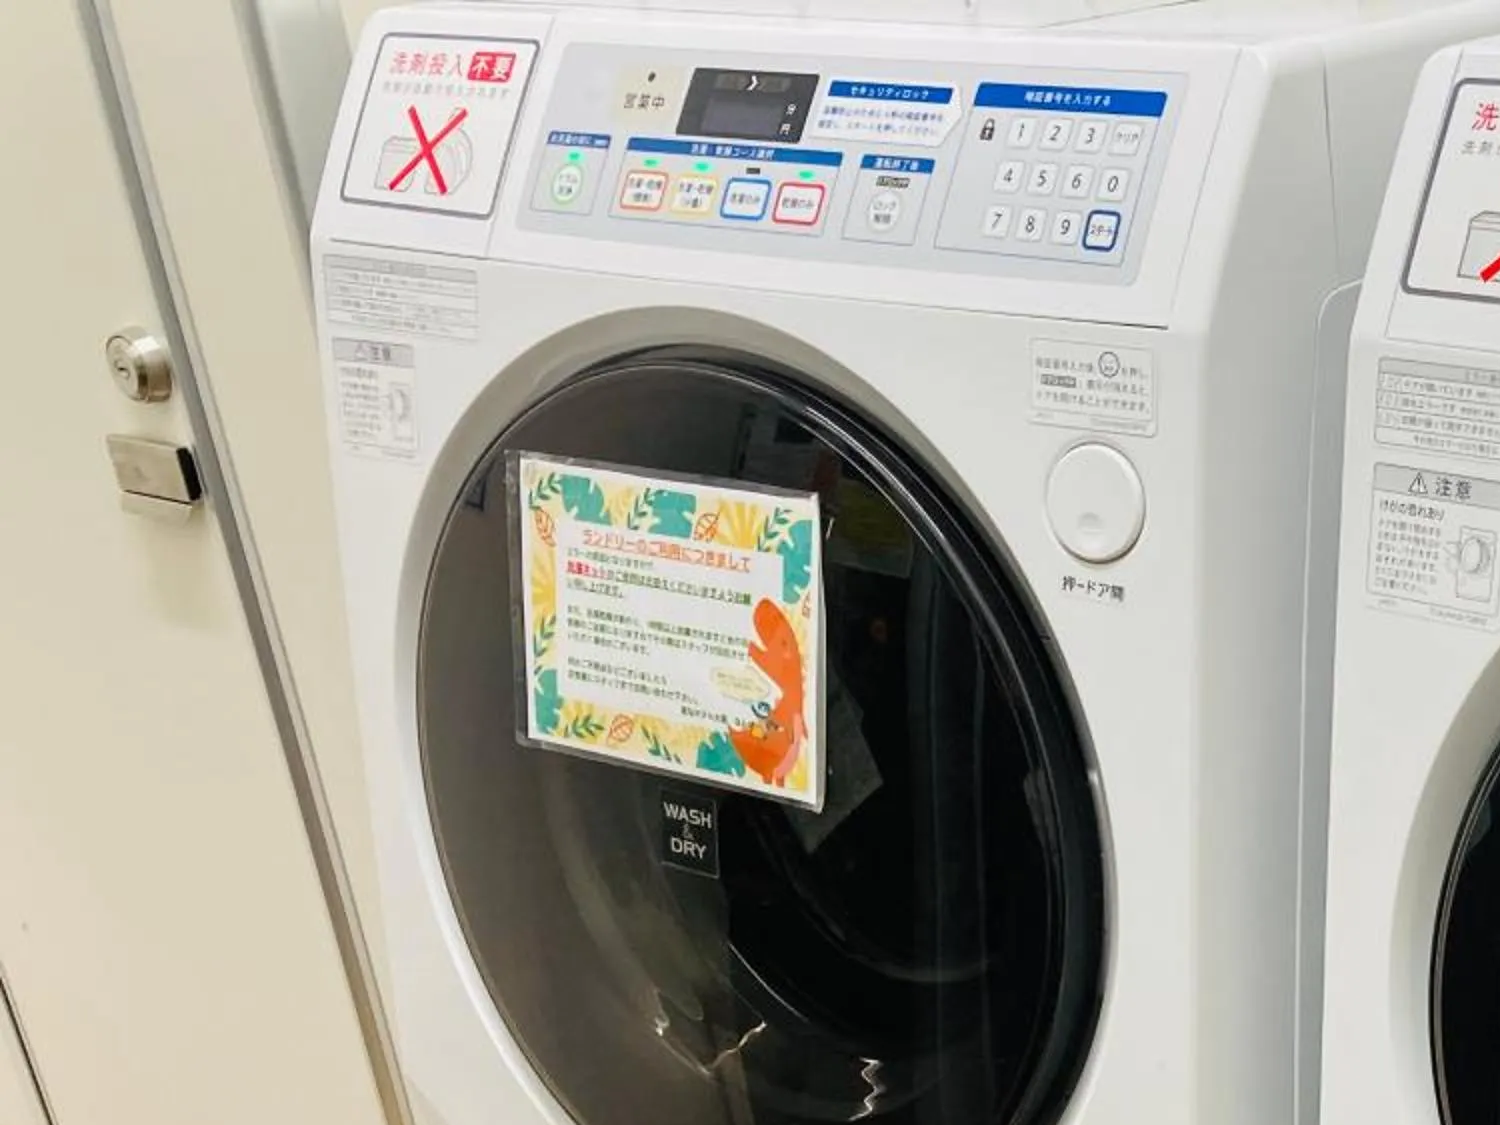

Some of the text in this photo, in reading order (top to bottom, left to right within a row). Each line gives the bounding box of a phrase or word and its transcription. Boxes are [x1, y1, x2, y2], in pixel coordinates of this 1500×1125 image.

[471, 53, 513, 80] 不要
[1050, 125, 1061, 141] 2
[1084, 127, 1096, 144] 3
[1003, 168, 1119, 193] 4 5 6 0
[992, 213, 1071, 235] 7 8 9
[1435, 477, 1473, 499] 注意
[663, 801, 712, 829] WASH
[671, 837, 707, 859] DRY
